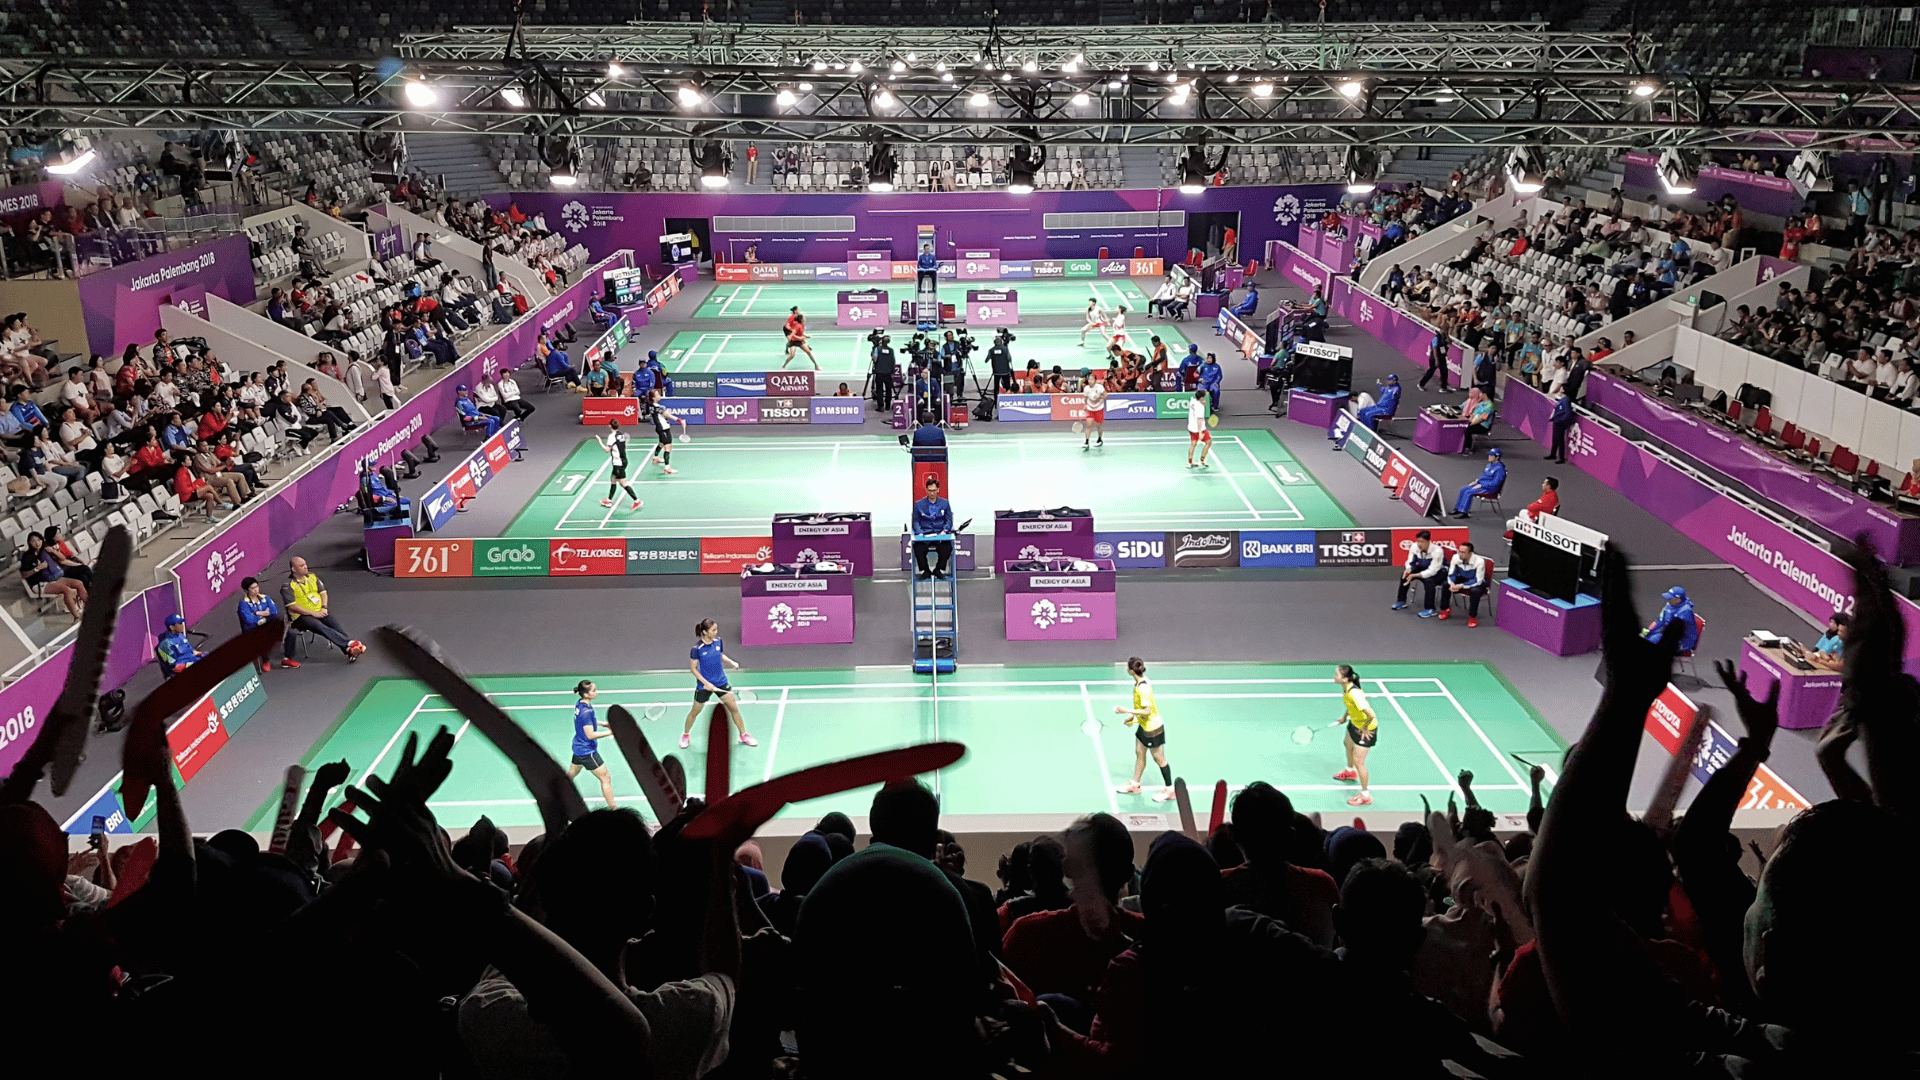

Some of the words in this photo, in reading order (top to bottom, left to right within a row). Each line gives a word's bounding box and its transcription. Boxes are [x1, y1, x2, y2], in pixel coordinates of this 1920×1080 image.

[19, 194, 38, 209] 2018
[131, 273, 161, 292] Jakarta
[160, 258, 200, 281] Palembang
[199, 252, 215, 268] 2018
[753, 266, 778, 274] QATAR
[1070, 262, 1092, 272] Grab
[1101, 262, 1127, 273] Aice
[1309, 347, 1338, 358] TISSOT
[894, 366, 900, 375] 2
[771, 375, 809, 387] QATAR
[666, 407, 689, 415] BANK
[690, 407, 704, 415] BRI
[761, 407, 809, 417] TISSOT
[815, 406, 860, 415] SAMSUNG
[895, 405, 902, 414] 2
[378, 425, 411, 456] Palembang
[1408, 476, 1431, 499] QATAR
[1533, 526, 1579, 552] TISSOT
[487, 543, 536, 563] Grab
[576, 549, 624, 558] TELKOMSEL
[1262, 543, 1293, 554] BANK
[1294, 543, 1314, 554] BRI
[1319, 544, 1388, 557] TISSOT
[1726, 525, 1772, 565] Jakarta
[1772, 550, 1844, 613] Palembang
[0, 705, 36, 750] 2018
[105, 809, 124, 832] BRI
